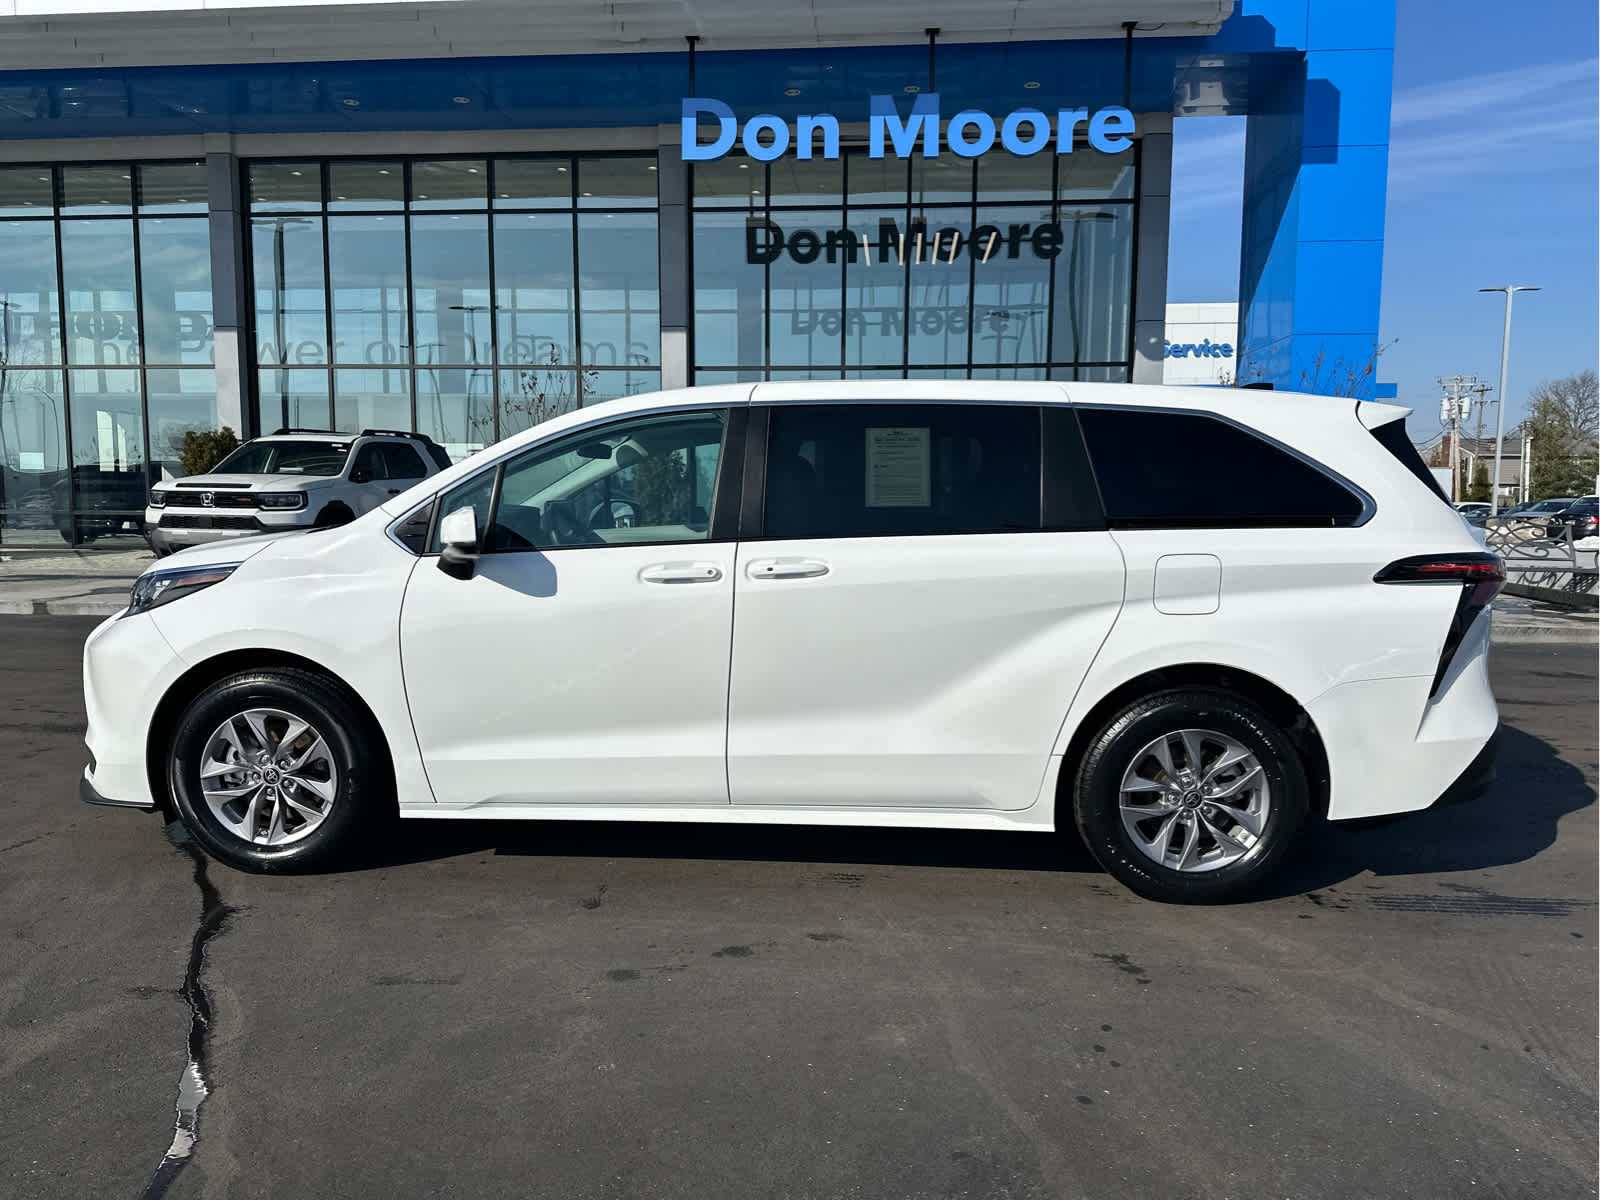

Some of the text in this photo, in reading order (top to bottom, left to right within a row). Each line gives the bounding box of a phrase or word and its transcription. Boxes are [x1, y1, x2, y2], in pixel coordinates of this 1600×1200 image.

[681, 92, 1136, 162] Don Moore
[746, 216, 1064, 265] Don Moore
